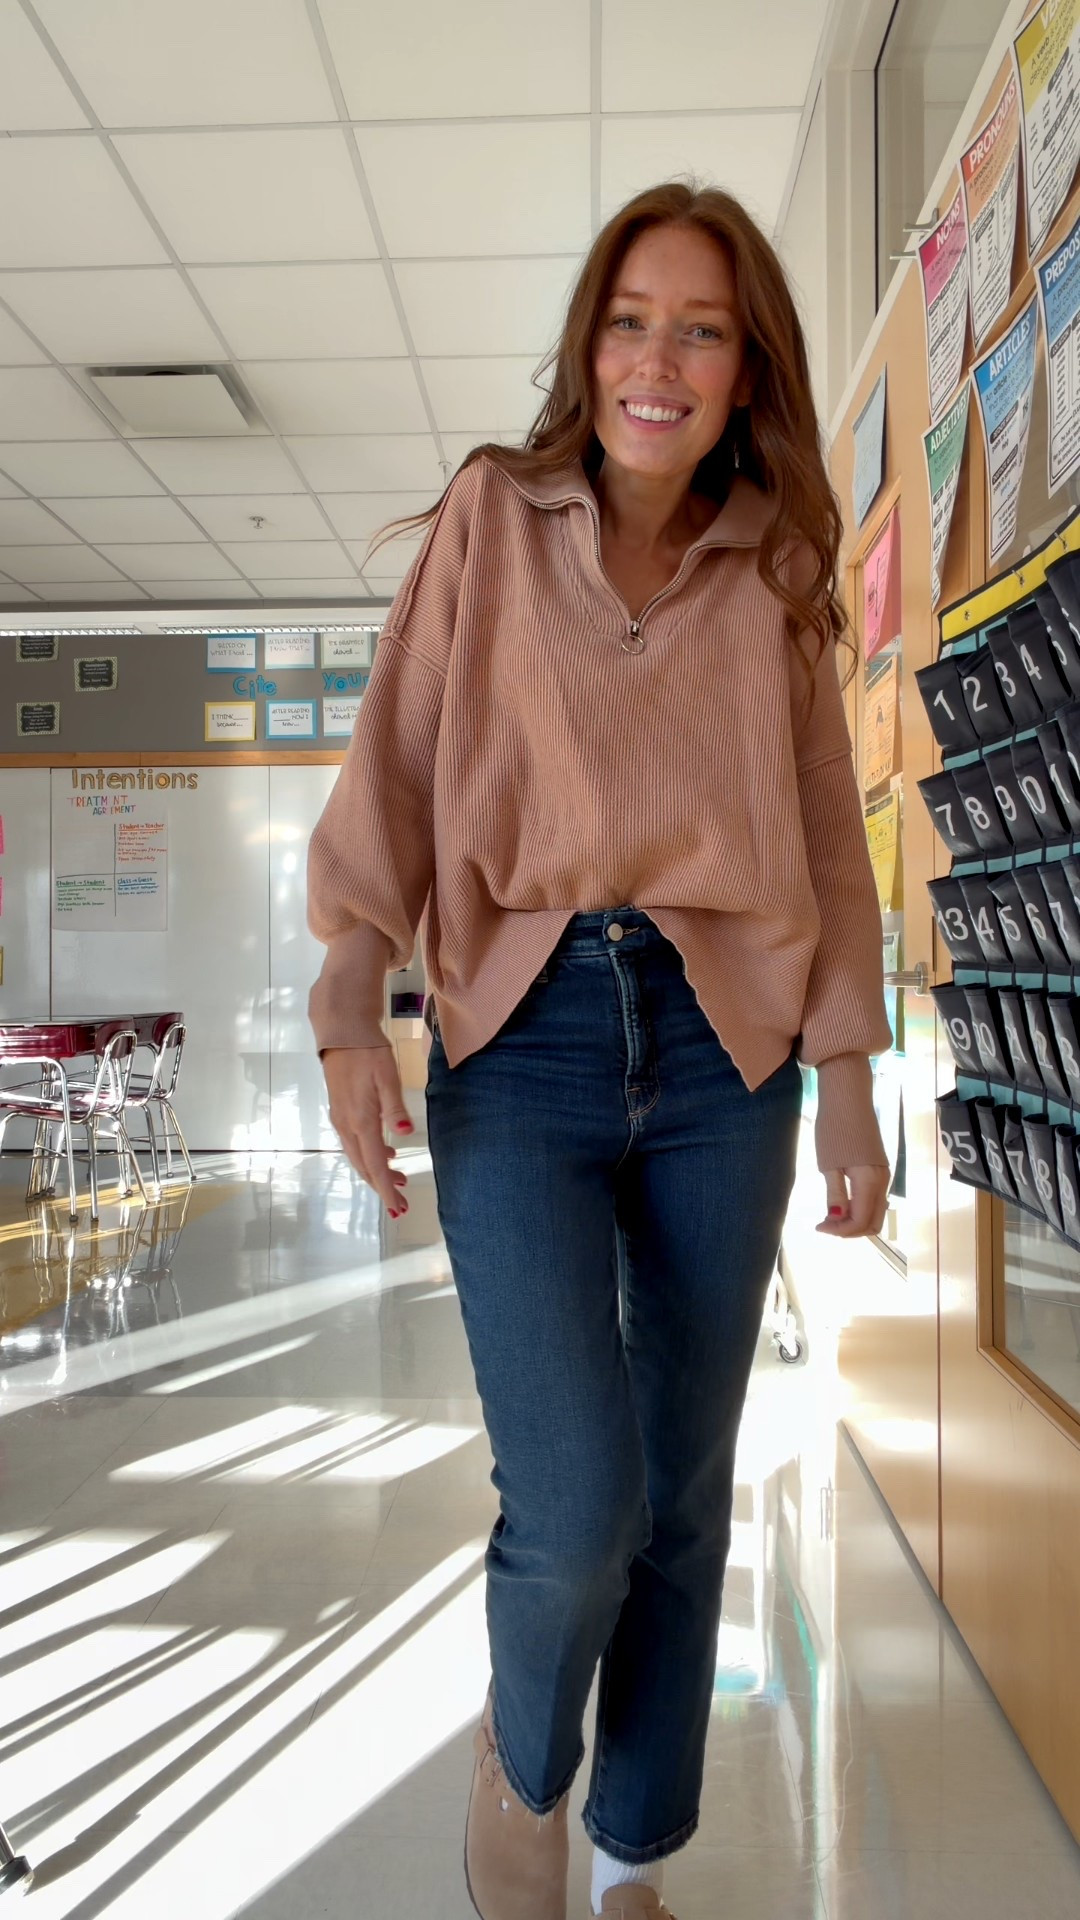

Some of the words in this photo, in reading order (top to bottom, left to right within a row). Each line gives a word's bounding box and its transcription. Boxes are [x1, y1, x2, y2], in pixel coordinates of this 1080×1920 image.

[1045, 225, 1080, 289] PREPOS
[989, 313, 1031, 382] ARTICLES
[930, 390, 968, 455] ADJECTIVES
[232, 675, 278, 699] Cite
[933, 689, 955, 720] 1
[963, 676, 988, 712] 2
[995, 661, 1017, 697] 3
[1020, 644, 1042, 680] 4
[67, 795, 128, 808] TREATMNT
[71, 768, 199, 790] Intentions
[92, 805, 136, 816] AGREMENT
[935, 802, 956, 837] 7
[964, 796, 991, 830] 8
[994, 785, 1017, 821] 9
